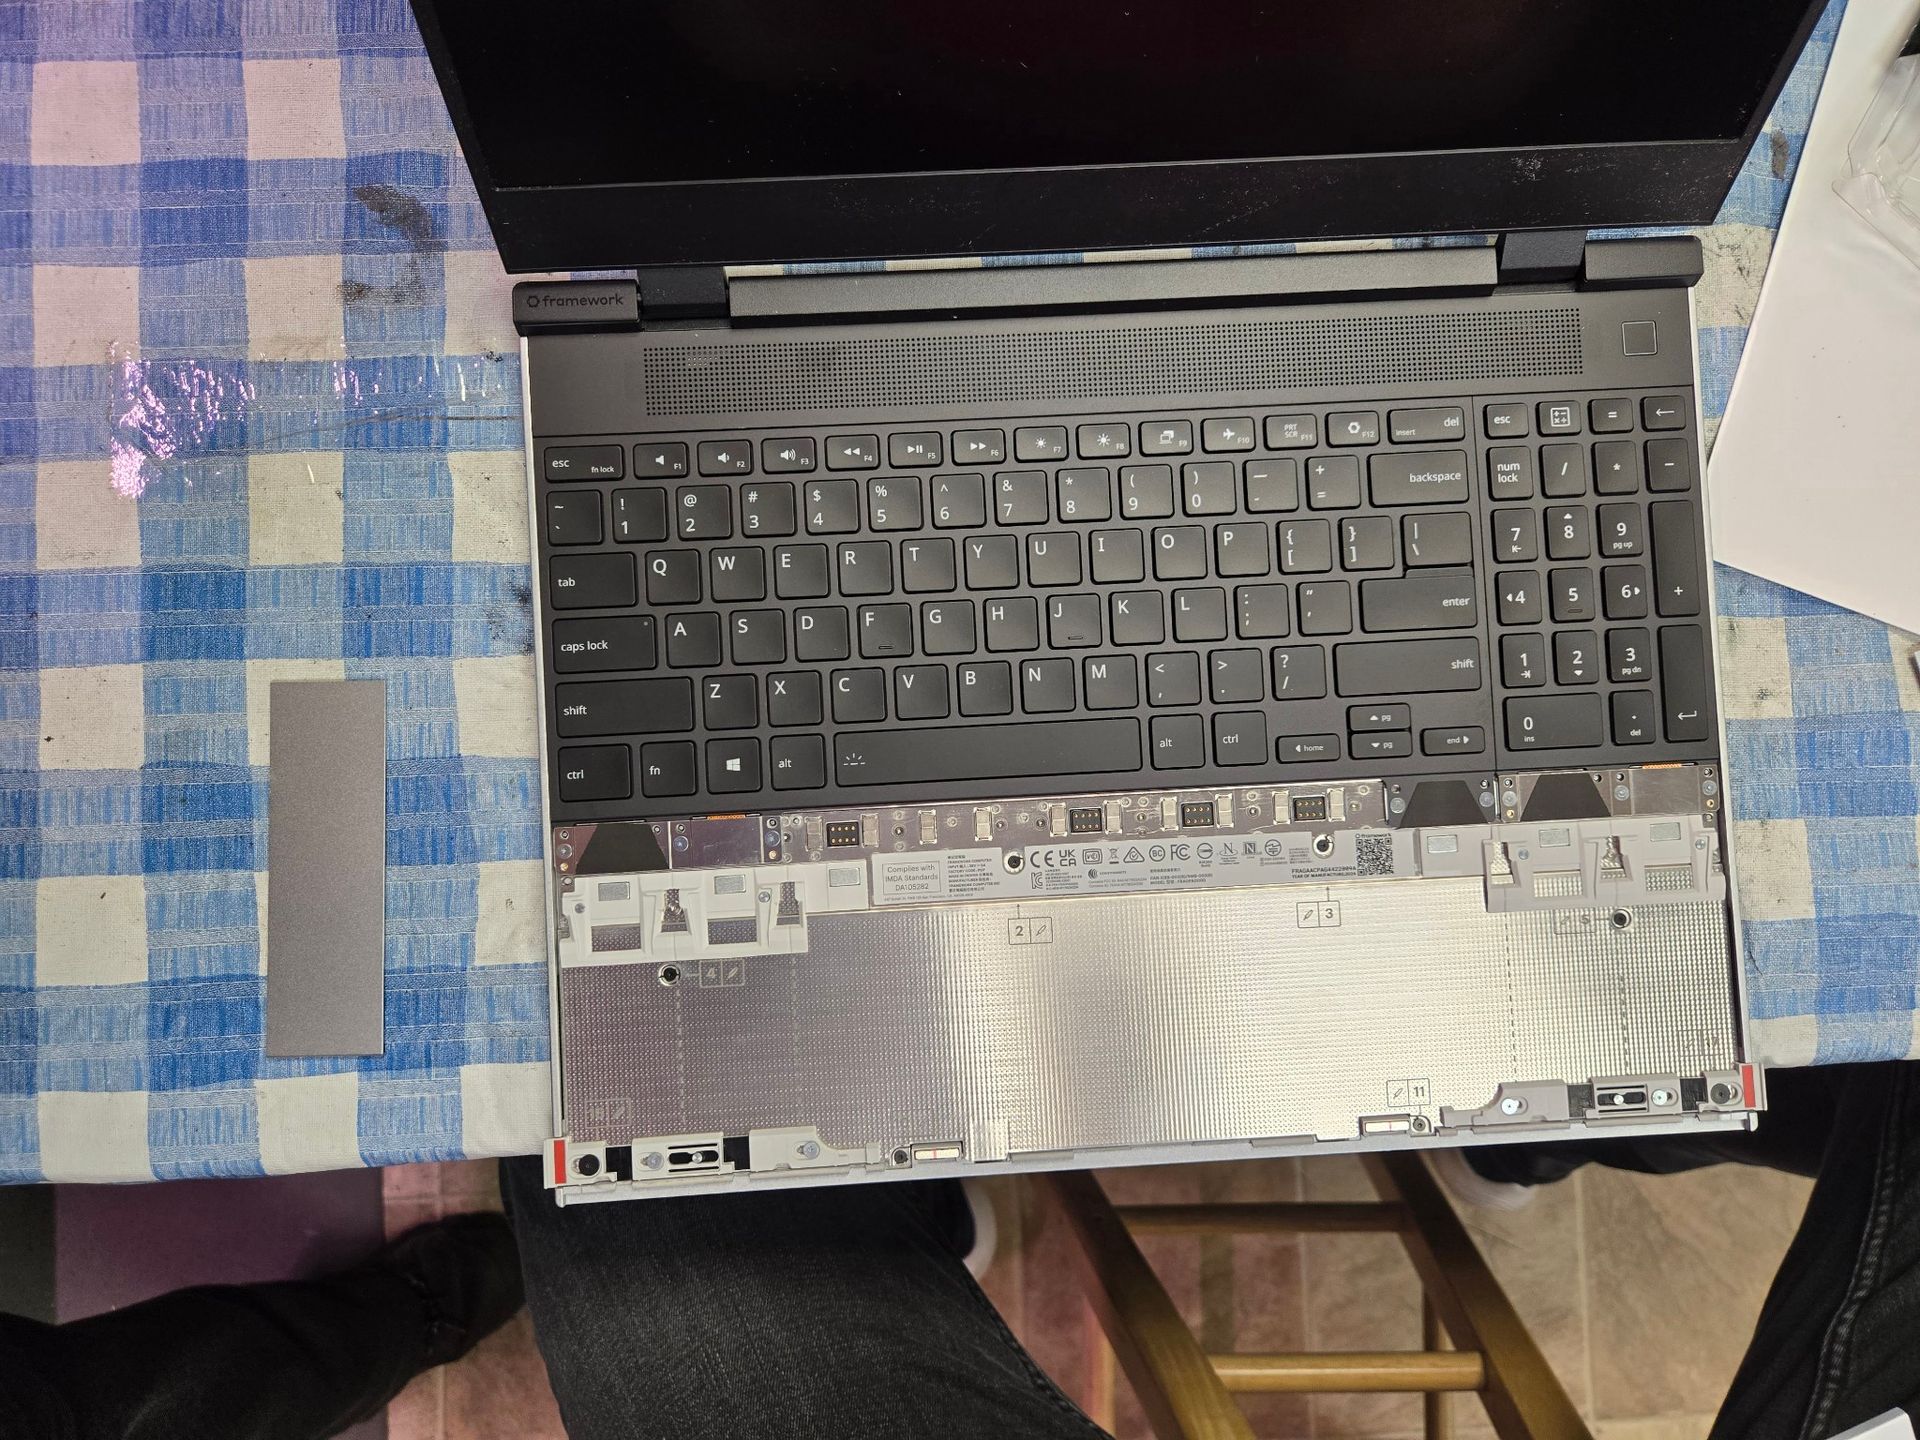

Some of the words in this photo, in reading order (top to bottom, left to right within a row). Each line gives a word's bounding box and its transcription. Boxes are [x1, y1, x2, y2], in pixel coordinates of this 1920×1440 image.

[543, 294, 624, 307] framework
[1444, 417, 1459, 427] del
[1494, 416, 1510, 424] esc
[552, 459, 569, 467] esc
[1498, 462, 1520, 471] num
[1410, 472, 1461, 483] backspace
[1498, 473, 1518, 483] lock
[875, 486, 887, 497] %
[1003, 480, 1013, 491] &
[684, 495, 697, 507] @
[748, 491, 758, 502] #
[813, 490, 821, 502] $
[1192, 494, 1201, 507] 0
[1004, 504, 1012, 516] 7
[1067, 501, 1075, 513] 8
[1129, 497, 1137, 510] 9
[814, 513, 823, 525] 4
[877, 510, 886, 522] 5
[941, 507, 949, 519] 6
[622, 521, 627, 534] 1
[686, 519, 695, 532] 2
[750, 515, 759, 528] 3
[1511, 528, 1520, 541] 7
[1564, 525, 1574, 539] 8
[1617, 523, 1626, 536] 9
[1098, 538, 1104, 551] I
[1162, 534, 1174, 549] O
[1224, 532, 1233, 545] P
[909, 547, 919, 561] T
[973, 545, 983, 558] Y
[1035, 541, 1046, 555] U
[718, 556, 735, 570] W
[782, 554, 790, 567] E
[846, 551, 856, 564] R
[653, 559, 666, 576] Q
[558, 578, 575, 587] tab
[1515, 591, 1525, 604] 4
[1569, 588, 1578, 601] 5
[1622, 585, 1631, 598] 6
[1118, 600, 1129, 614] K
[1181, 597, 1190, 610] L
[1443, 597, 1470, 607] enter
[930, 609, 941, 623] G
[992, 606, 1003, 620] H
[1054, 603, 1062, 617] J
[802, 616, 813, 629] D
[866, 612, 874, 626] F
[674, 622, 687, 636] A
[738, 619, 748, 633] S
[561, 643, 584, 653] caps
[587, 640, 608, 650] lock
[1521, 653, 1527, 666] 1
[1573, 651, 1582, 664] 2
[1626, 648, 1635, 661] 3
[1281, 655, 1288, 668] ?
[1451, 659, 1474, 669] shift
[1029, 667, 1041, 681] N
[1092, 664, 1106, 678] M
[903, 675, 914, 688] V
[966, 671, 976, 685] B
[710, 684, 721, 698] Z
[775, 681, 786, 695] X
[839, 678, 849, 692] C
[564, 705, 587, 715] shift
[1524, 717, 1533, 730] 0
[1160, 738, 1172, 747] alt
[1223, 734, 1238, 744] ctrl
[1383, 741, 1392, 749] pg
[1447, 736, 1460, 744] end
[779, 759, 791, 768] alt
[567, 770, 584, 779] ctrl
[649, 766, 660, 775] fn
[1059, 849, 1076, 858] UK
[1059, 858, 1077, 867] CA
[885, 875, 903, 883] IMDA
[895, 883, 929, 891] DA105282
[1325, 908, 1334, 919] 3
[1015, 925, 1024, 936] 2
[706, 967, 716, 979] 4
[1413, 1086, 1424, 1097] 11
